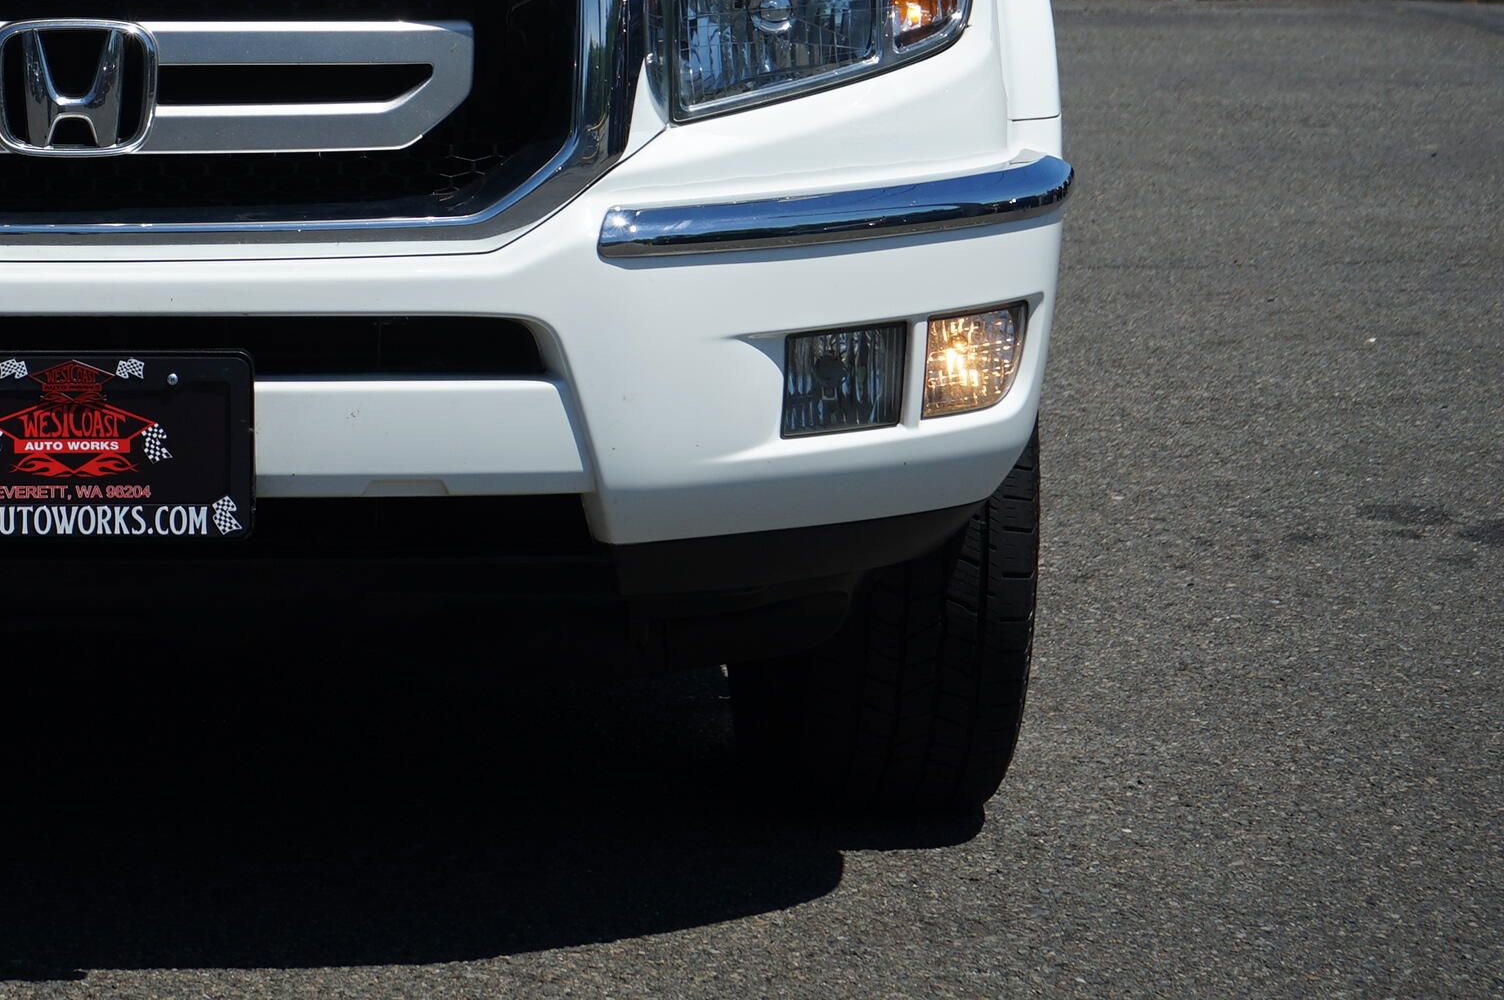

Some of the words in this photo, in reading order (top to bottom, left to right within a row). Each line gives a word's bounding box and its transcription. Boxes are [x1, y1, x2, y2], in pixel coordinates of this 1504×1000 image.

[24, 441, 63, 451] AUTO
[67, 441, 119, 451] WORKS
[75, 485, 103, 499] WA
[105, 485, 152, 499] 98204
